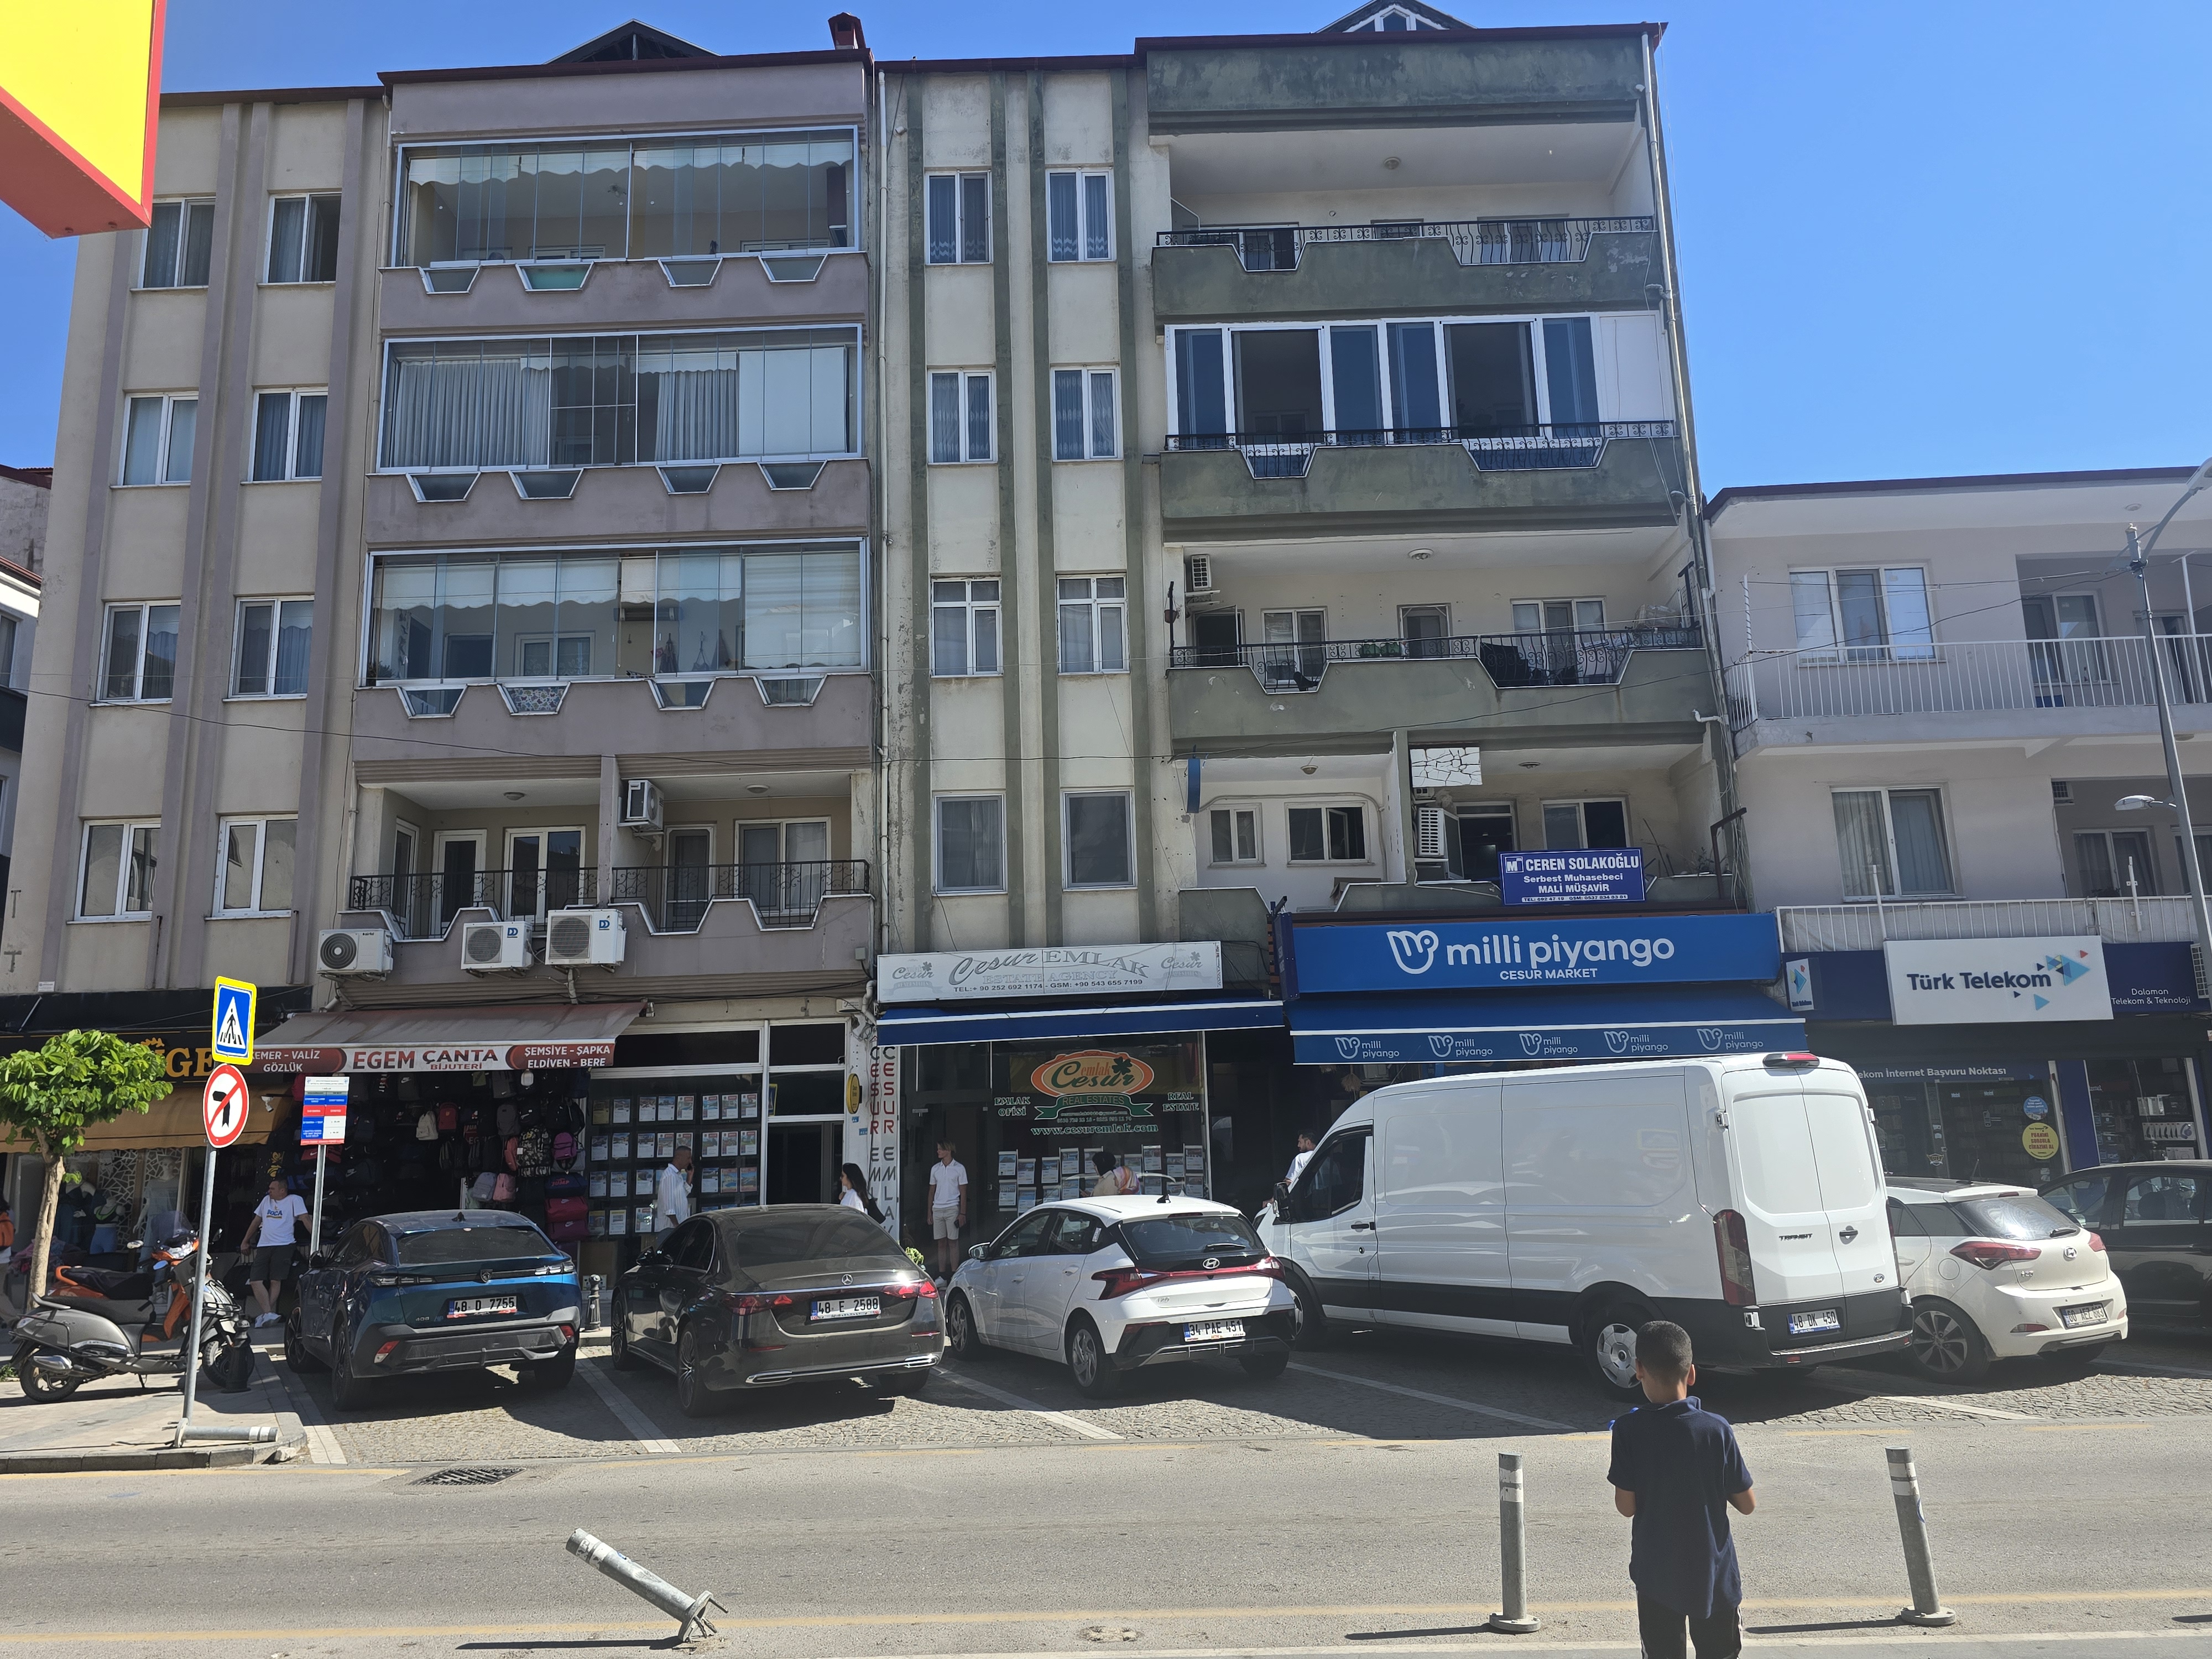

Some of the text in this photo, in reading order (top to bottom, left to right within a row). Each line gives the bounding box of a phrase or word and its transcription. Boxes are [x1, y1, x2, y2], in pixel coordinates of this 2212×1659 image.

[1526, 852, 1639, 872] CEREN SOLAKOĞLU
[1524, 873, 1623, 883] Serbest Muhasebeci
[1538, 882, 1610, 894] MALİ MÜŞAVİR
[1447, 934, 1674, 969] milli piyango
[948, 950, 1150, 985] Cesur EMLAK
[1161, 957, 1203, 969] Cesur
[893, 967, 935, 979] Cesur
[982, 970, 1117, 984] ESTATE AGENCY
[1500, 968, 1598, 980] CESUR MARKET
[1907, 971, 2052, 990] Türk Telekom
[2154, 996, 2191, 1005] Teknoloji
[1543, 1036, 1561, 1045] milli
[1631, 1034, 1650, 1043] milli
[1724, 1032, 1744, 1040] milli
[1361, 1040, 1381, 1049] milli
[1455, 1039, 1474, 1047] milli
[1631, 1043, 1668, 1053] piyango
[1726, 1040, 1764, 1050] piyango
[291, 1049, 320, 1060] VALİZ
[524, 1045, 567, 1057] ŞEMSİYE
[576, 1045, 611, 1056] ŞAPKA
[1363, 1050, 1400, 1059] piyango
[1456, 1047, 1493, 1057] piyango
[1544, 1045, 1578, 1055] piyango
[352, 1049, 498, 1070] EGEM ÇANTA
[528, 1057, 570, 1068] ELDİVEN
[580, 1057, 606, 1067] BERE
[263, 1062, 303, 1072] GÖZLÜK
[1081, 1062, 1111, 1076] emlak
[1854, 1067, 2007, 1079] ekom İnternet Başvuru Noktası
[1051, 1061, 1135, 1088] Cesur
[870, 1046, 880, 1135] CESUR
[883, 1046, 896, 1134] CESUR
[994, 1096, 1031, 1105] EMLAK
[1062, 1095, 1125, 1105] REAL ESTATES
[1167, 1092, 1194, 1101] REAL
[1162, 1102, 1200, 1112] ESTATE
[1030, 1123, 1159, 1135] www.cesuremlak.com
[455, 1297, 514, 1313] 48 D 7755
[818, 1297, 878, 1314] 48 E 2588
[1793, 1311, 1837, 1329] 48 DK 450
[2080, 1307, 2093, 1321] AEZ
[1190, 1319, 1241, 1336] 34 PAE 451
